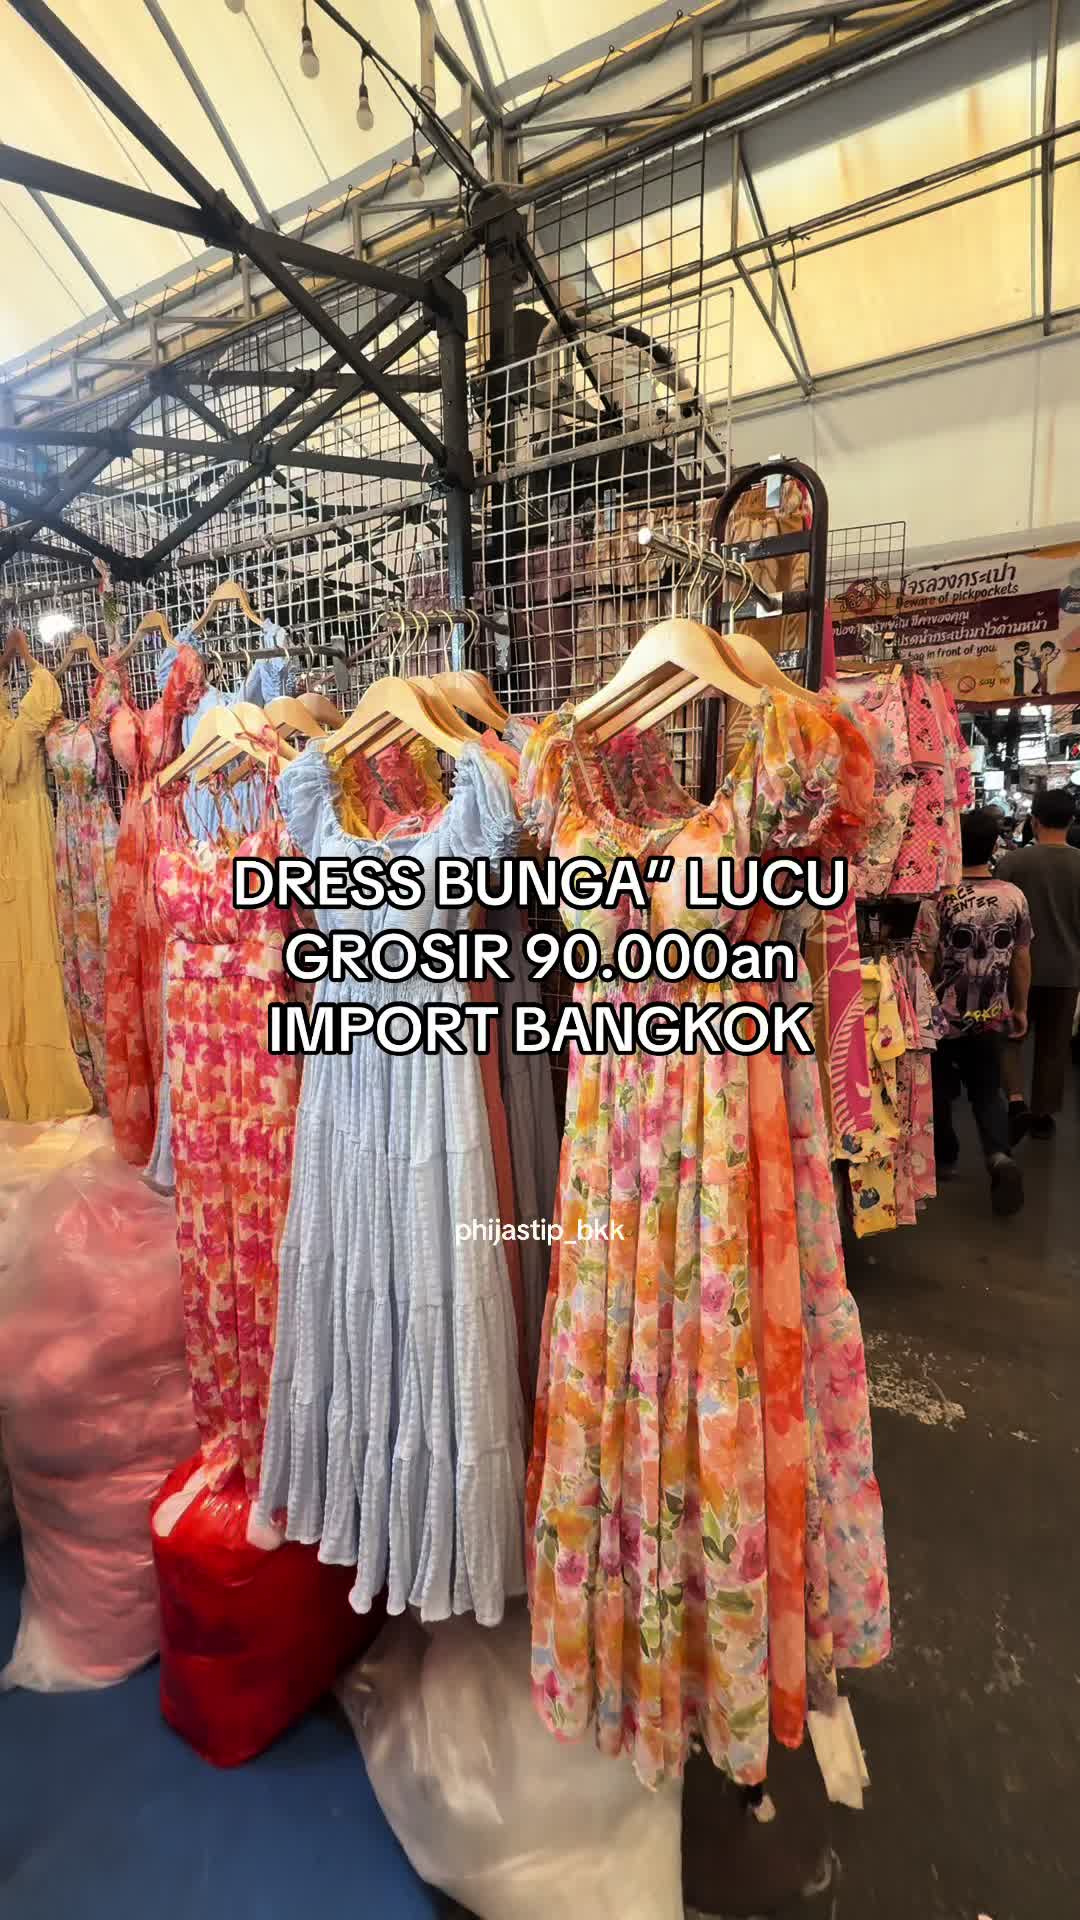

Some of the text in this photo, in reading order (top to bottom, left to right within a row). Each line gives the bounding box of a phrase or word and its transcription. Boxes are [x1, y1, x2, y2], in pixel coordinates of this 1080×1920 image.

[938, 591, 949, 605] of
[952, 582, 1019, 605] pickpockets
[937, 645, 961, 657] front
[963, 644, 975, 655] of
[979, 677, 996, 688] say
